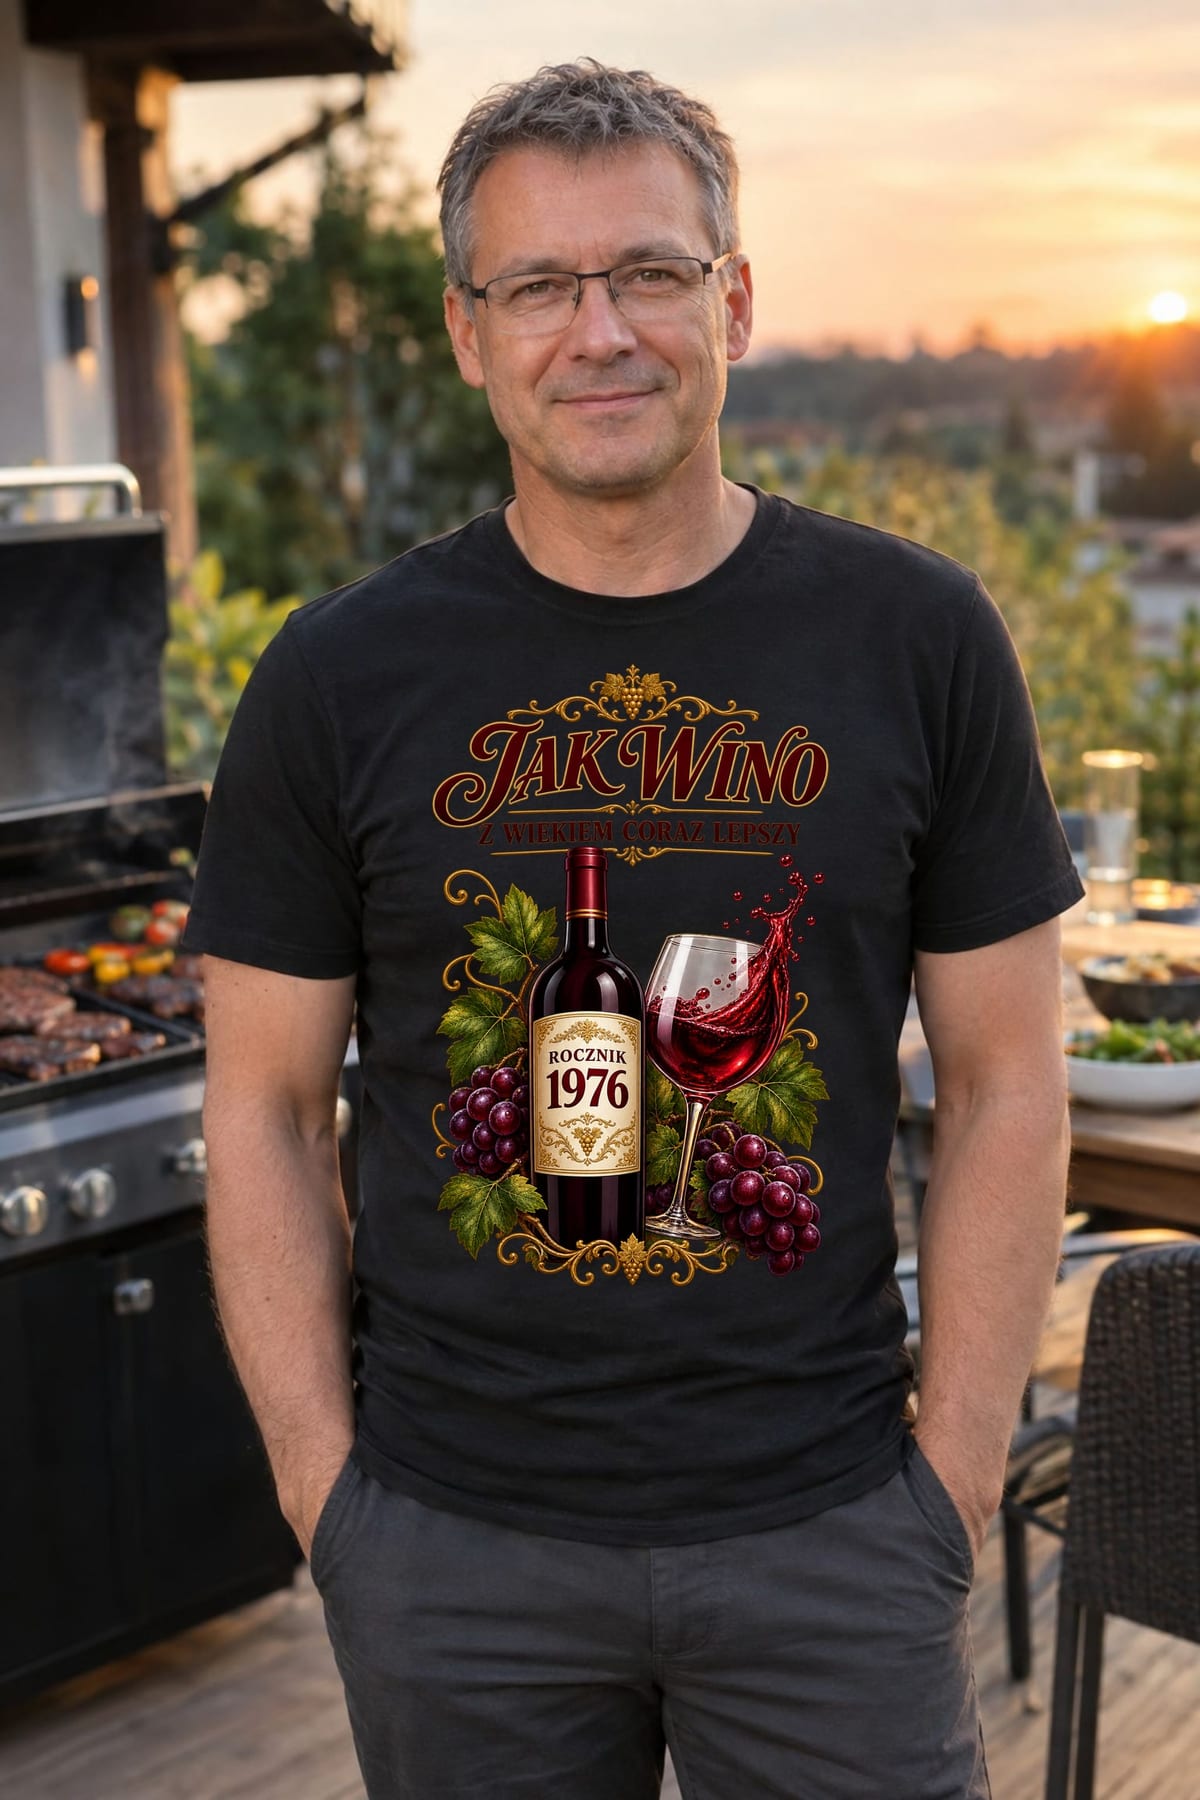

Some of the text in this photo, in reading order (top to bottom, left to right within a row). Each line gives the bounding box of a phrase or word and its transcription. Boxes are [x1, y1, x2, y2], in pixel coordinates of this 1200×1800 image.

[433, 719, 829, 828] JAK WINO
[478, 820, 801, 847] Z WIEKIEM CORAZ LEPSZY
[549, 1048, 627, 1064] ROCZNIK
[546, 1067, 629, 1109] 1976
